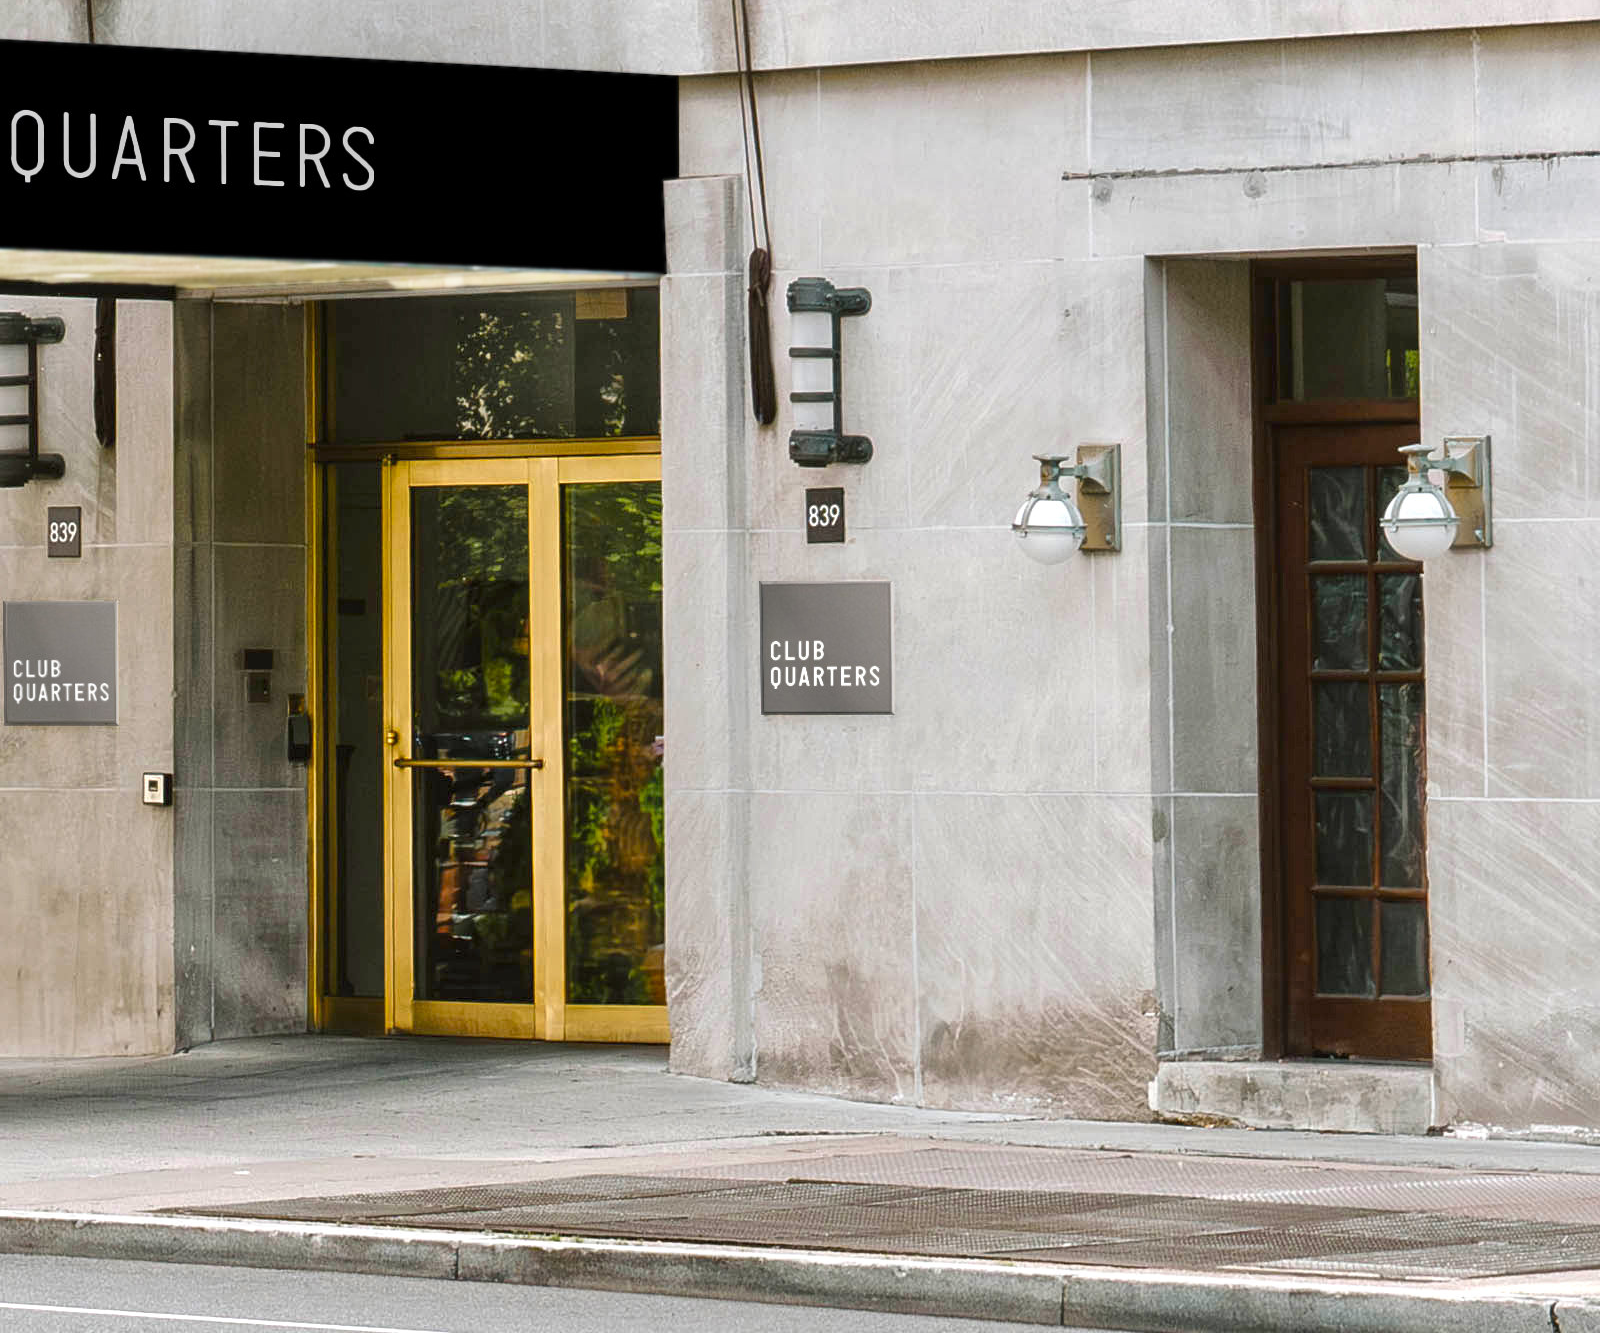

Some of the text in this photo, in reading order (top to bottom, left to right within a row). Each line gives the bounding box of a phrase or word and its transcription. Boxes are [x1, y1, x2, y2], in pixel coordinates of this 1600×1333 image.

[10, 109, 376, 191] QUARTERS
[808, 504, 841, 527] 839
[49, 521, 78, 543] 839
[770, 640, 825, 661] CLUB
[13, 659, 62, 679] CLUB
[770, 665, 880, 690] QUARTERS
[13, 682, 110, 704] QUARTERS
